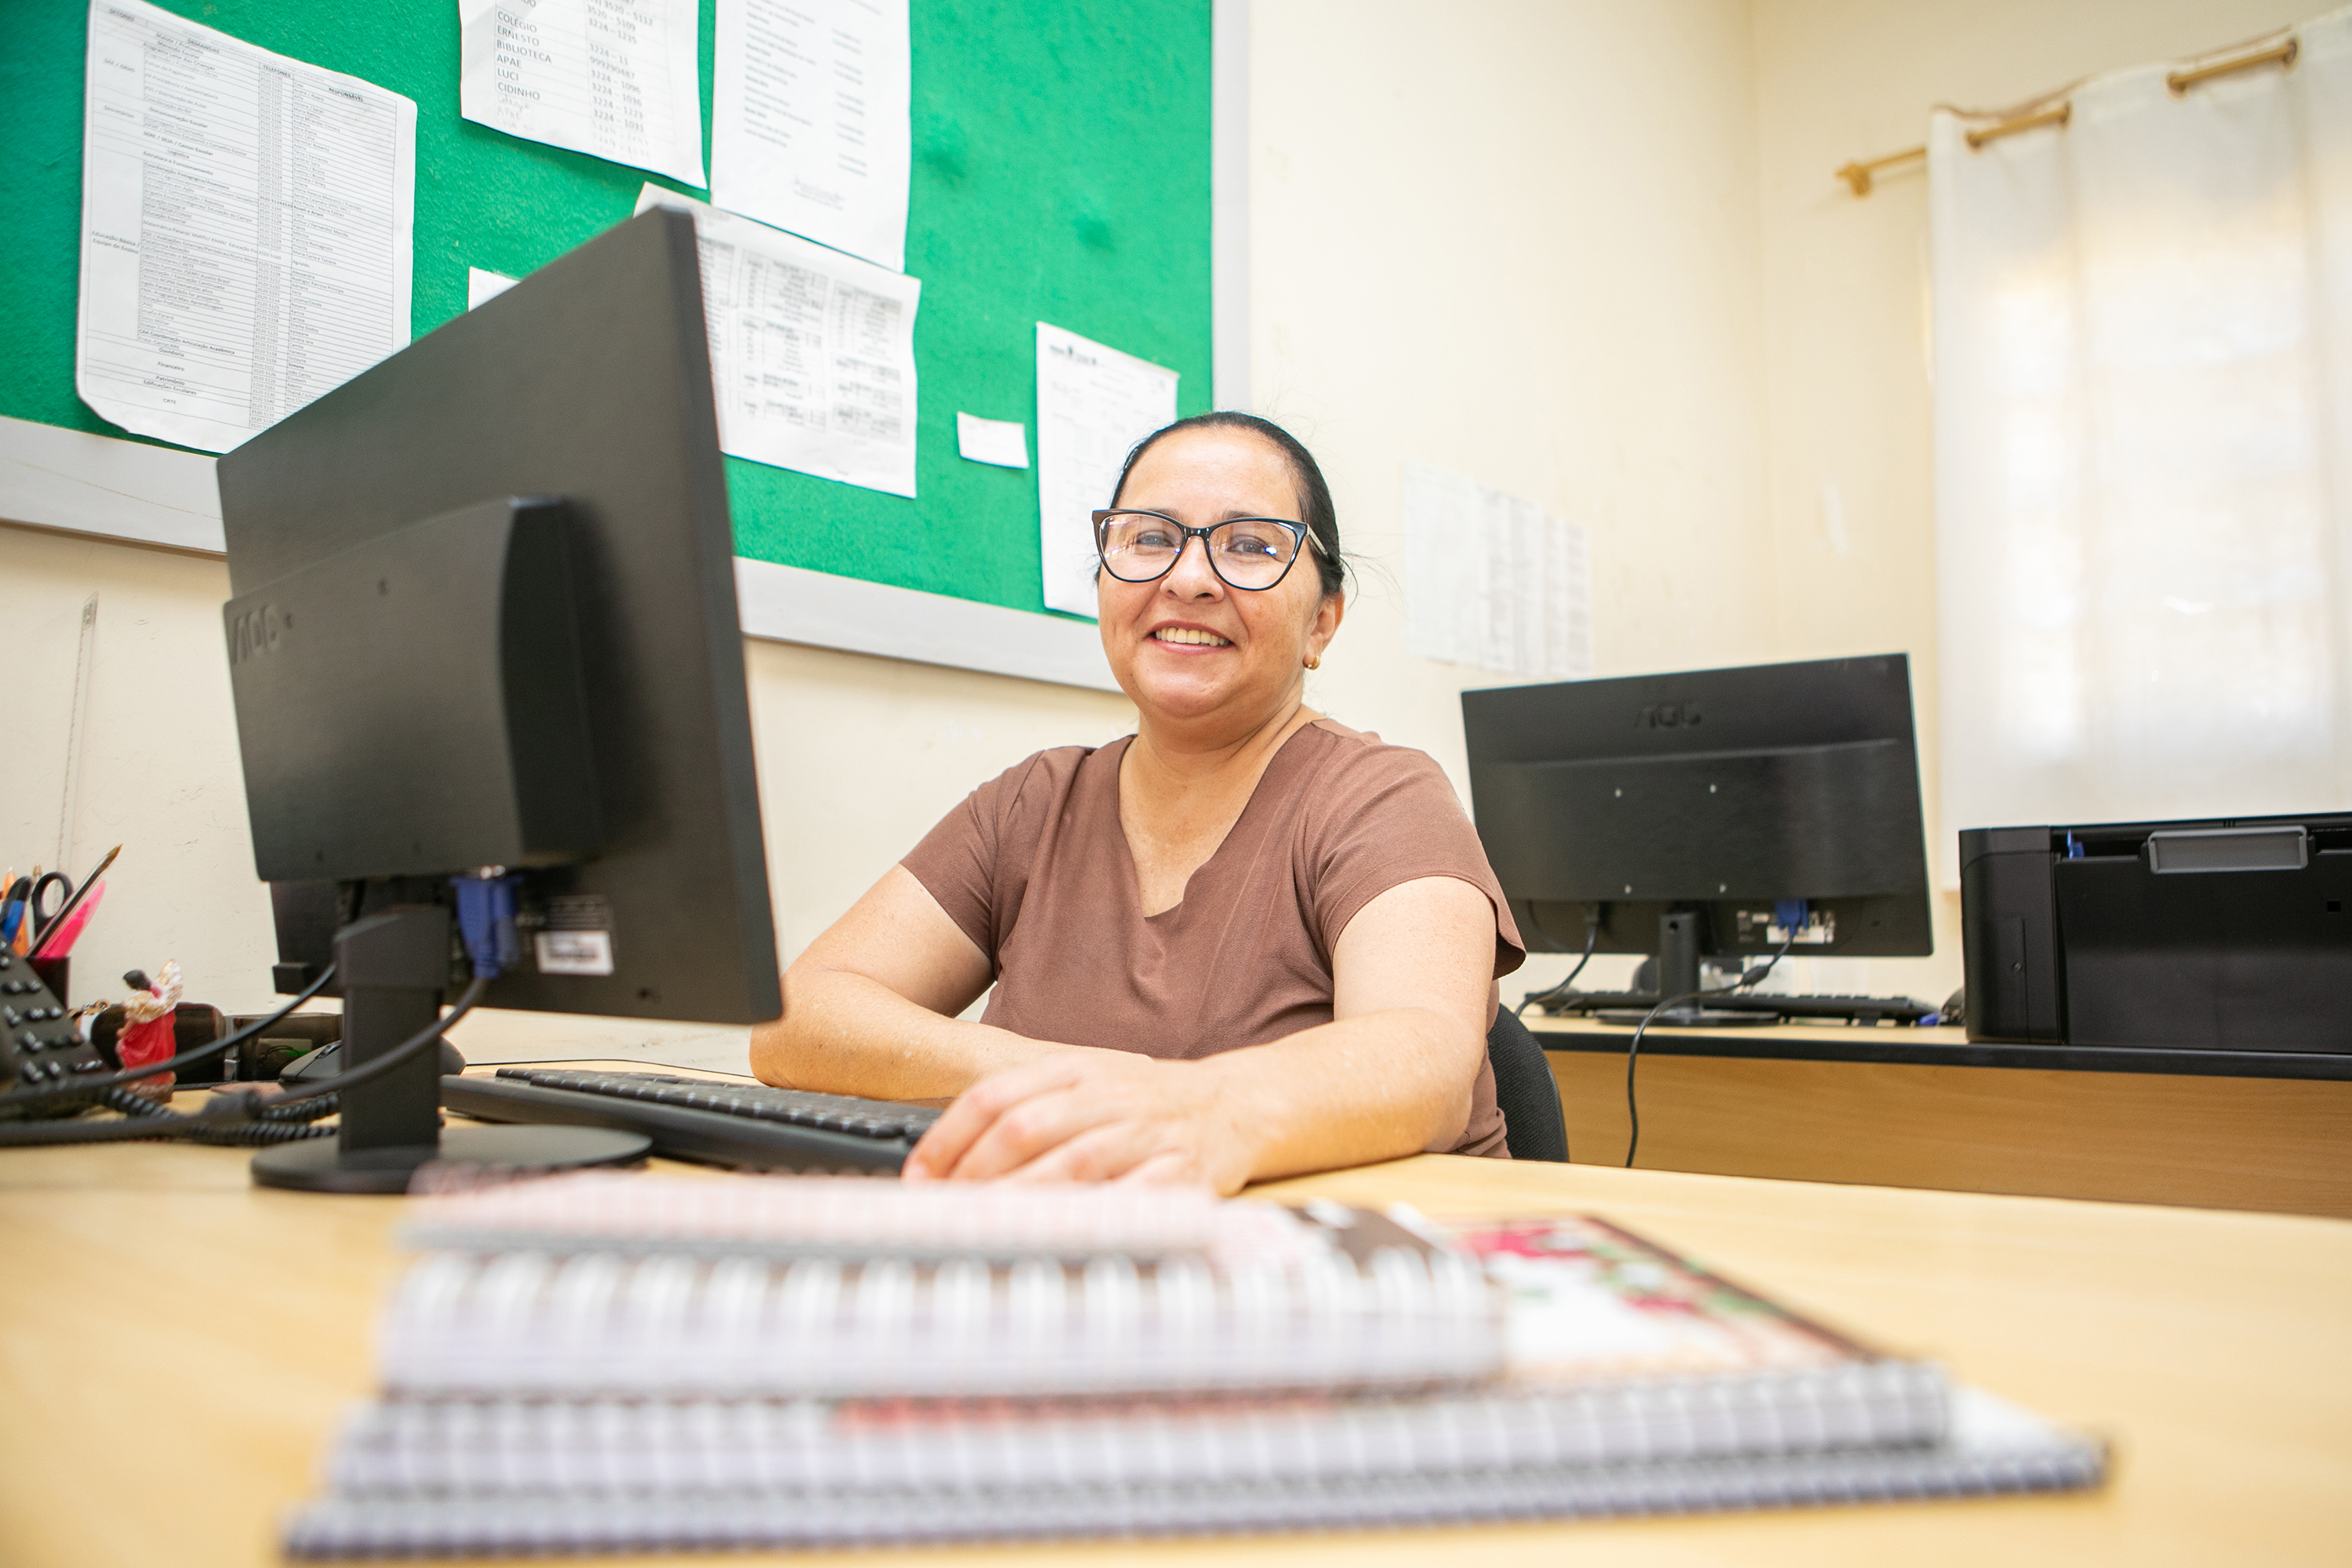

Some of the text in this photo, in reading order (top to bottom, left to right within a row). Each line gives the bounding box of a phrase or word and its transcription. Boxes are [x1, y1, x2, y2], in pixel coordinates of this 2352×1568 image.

[587, 5, 607, 19] 3520
[498, 11, 537, 33] COLÉGIO
[497, 25, 539, 46] ERNESTO
[158, 40, 199, 60] Merenda Escolar
[187, 39, 219, 53] DEMANDAS
[497, 39, 552, 64] BIBLIOTECA
[497, 54, 522, 69] APAE
[263, 65, 290, 77] TELEFONES
[497, 68, 519, 81] LUCI
[328, 86, 363, 102] RESPONSÁVEL
[498, 82, 540, 100] CIDINHO
[149, 106, 188, 123] Documentação
[190, 119, 207, 129] Escolar
[195, 147, 213, 156] Escolar
[173, 159, 213, 176] Funcionamento
[229, 242, 250, 252] Educação
[200, 259, 219, 268] (alunos)
[292, 270, 314, 279] Alessandra
[174, 274, 197, 284] Formação
[198, 280, 225, 290] Continuada
[197, 293, 220, 303] prosperity
[159, 347, 184, 357] Ouvidoria
[158, 361, 184, 371] Financeiro
[156, 375, 184, 385] Patrimônio
[143, 380, 196, 395] Edificações Escolares
